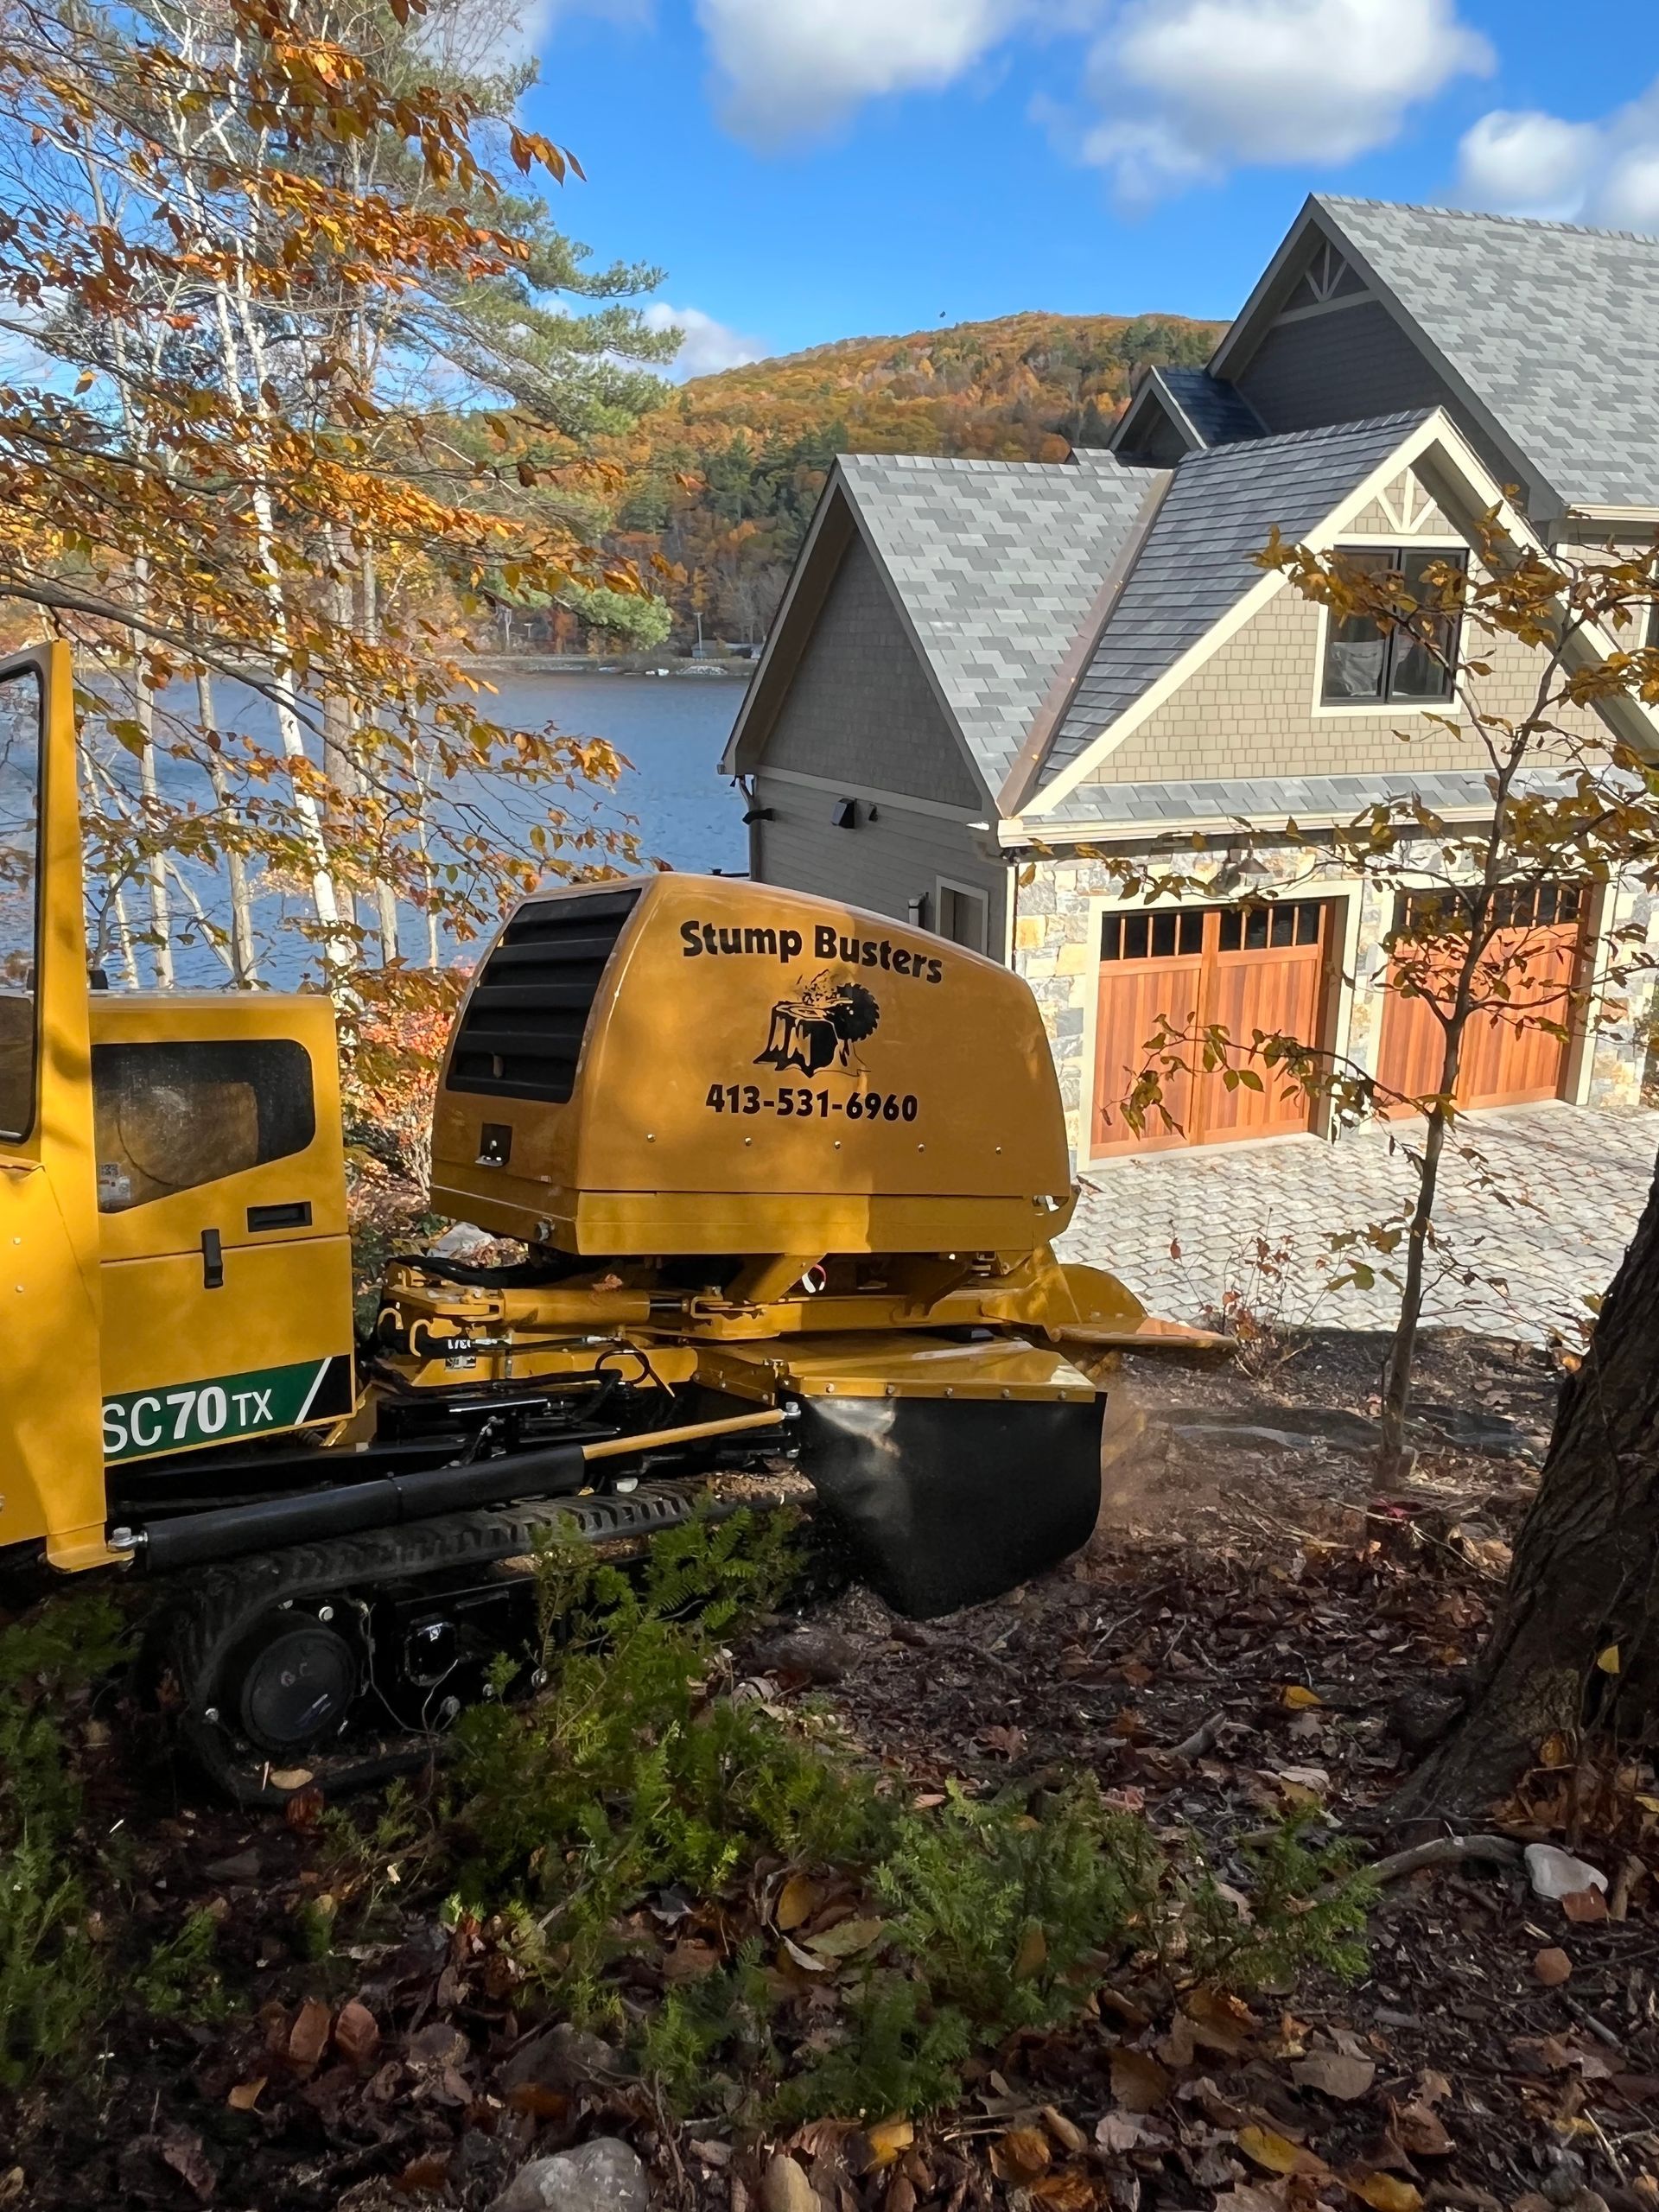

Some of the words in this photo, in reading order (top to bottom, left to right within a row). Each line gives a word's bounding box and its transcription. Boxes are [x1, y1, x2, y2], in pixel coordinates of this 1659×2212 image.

[680, 920, 803, 963] Stump
[815, 925, 942, 983] Busters
[705, 1084, 918, 1122] 413-531-6960
